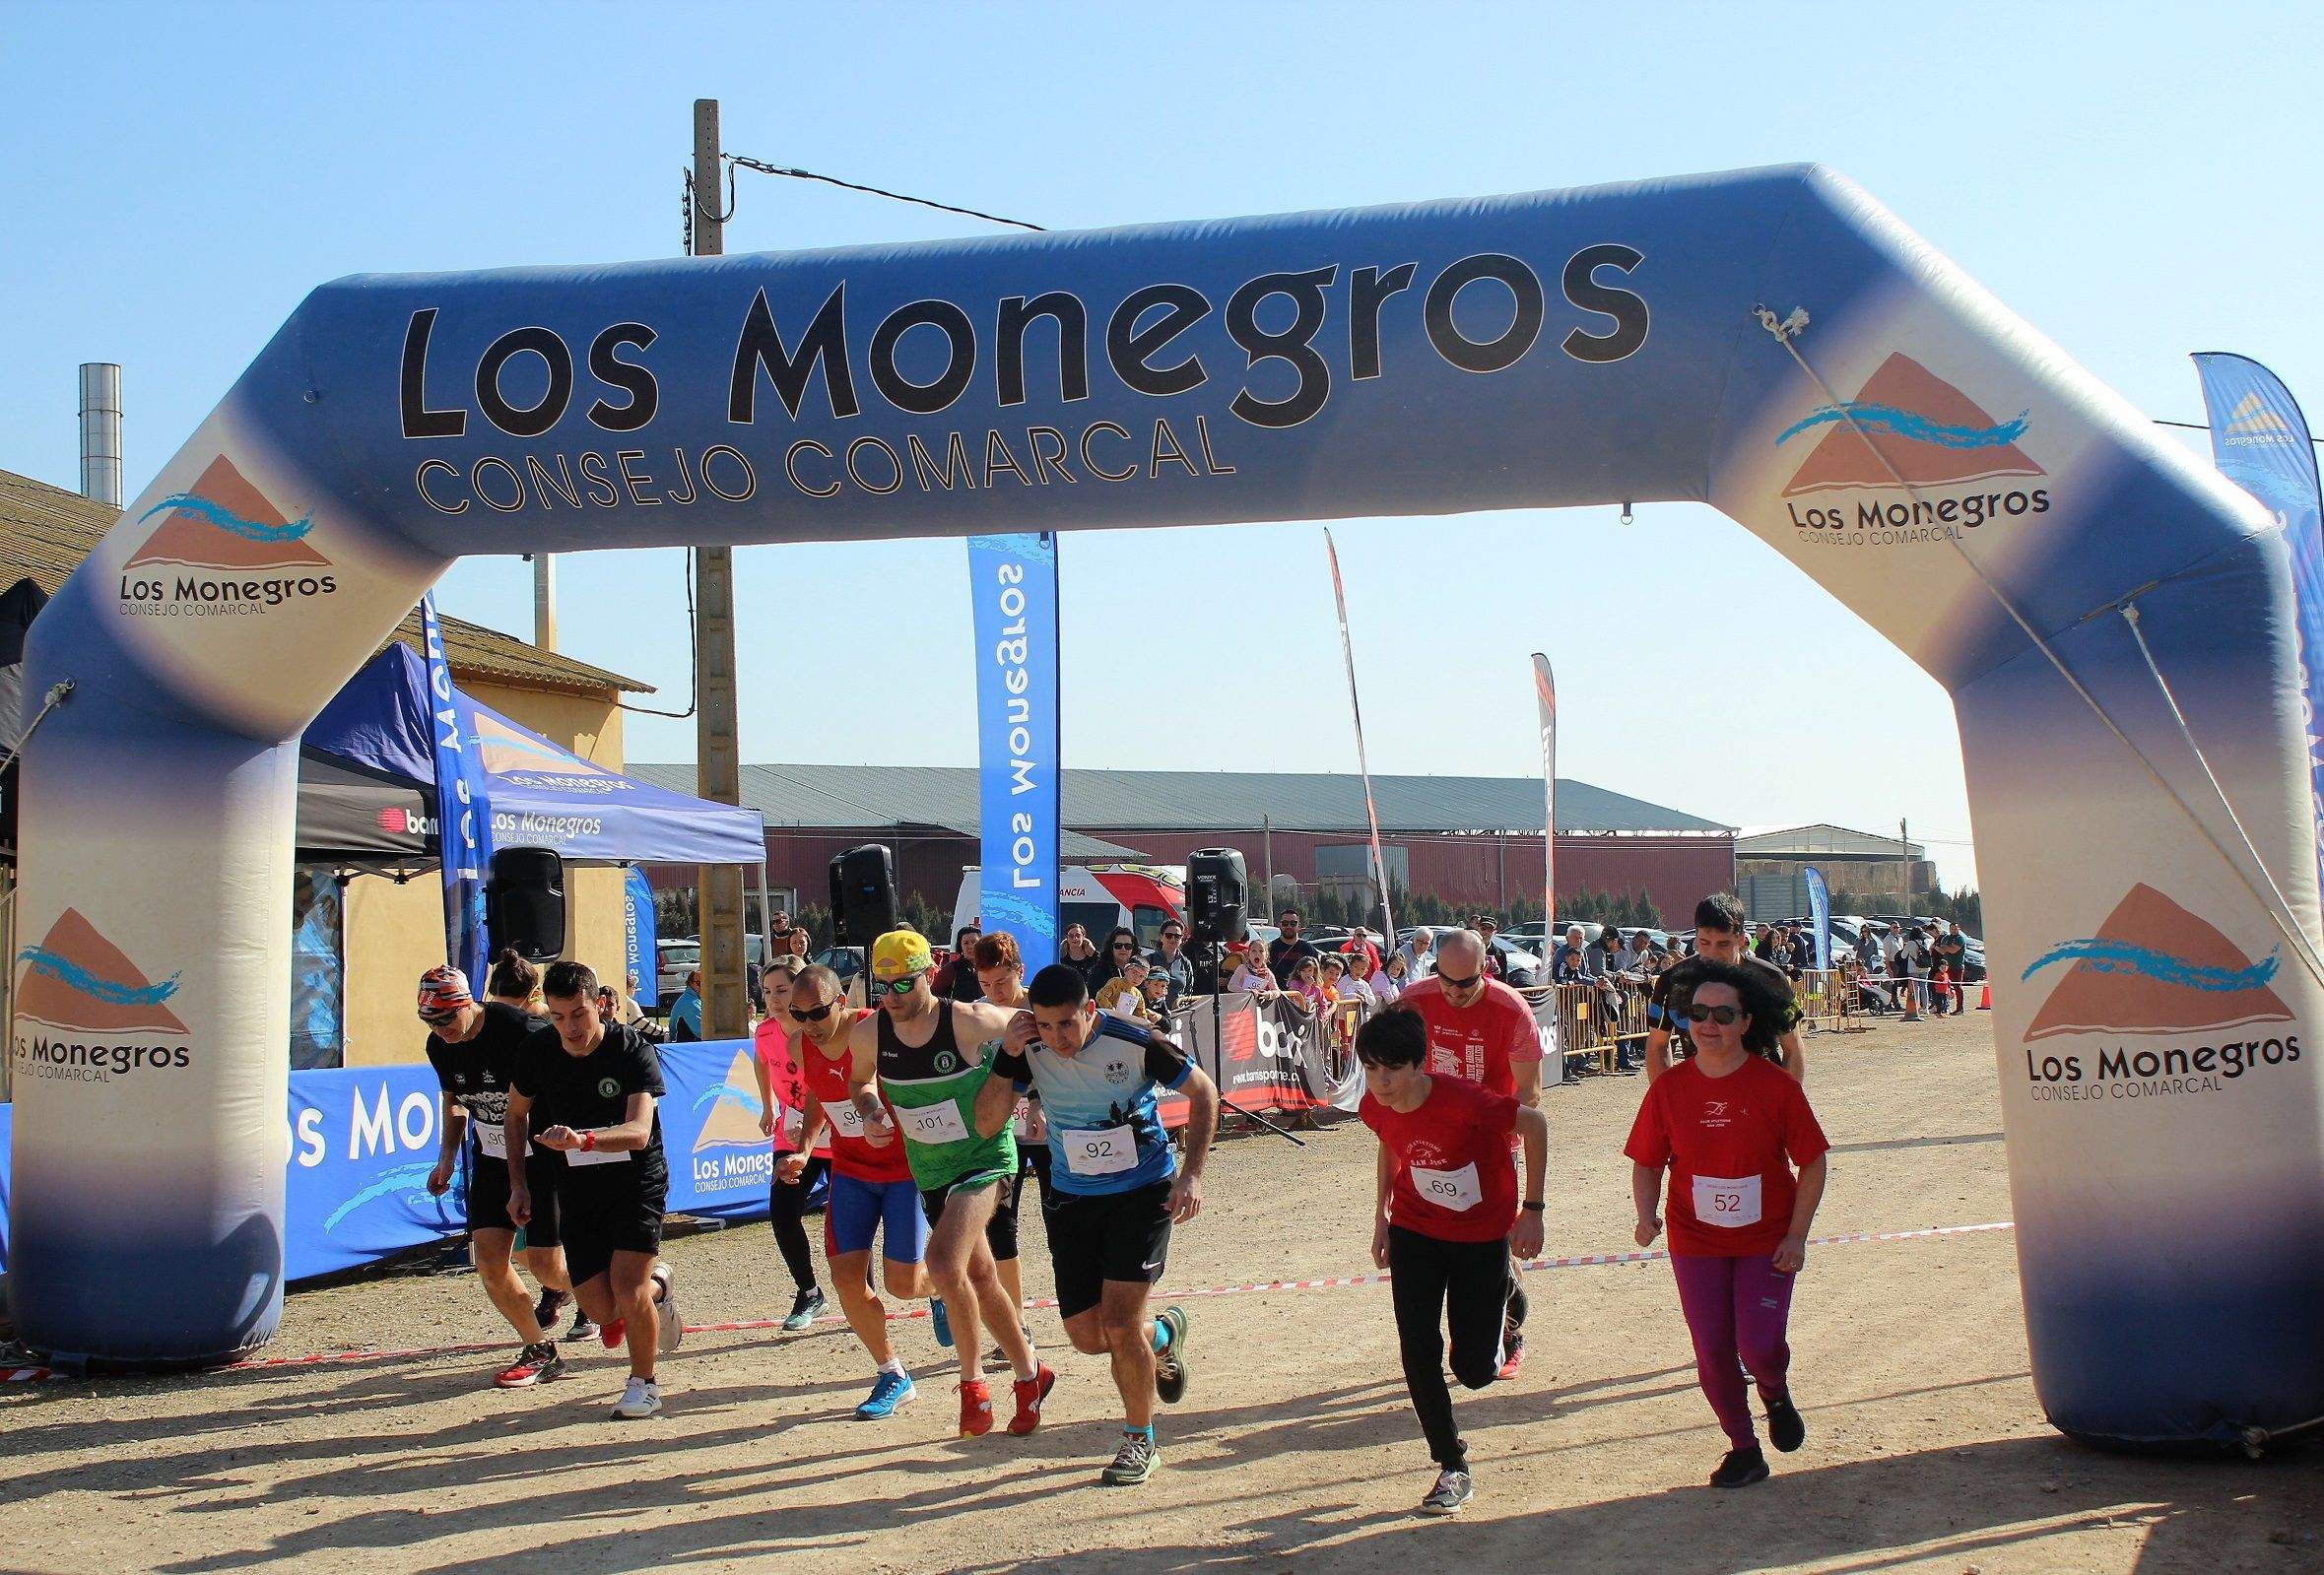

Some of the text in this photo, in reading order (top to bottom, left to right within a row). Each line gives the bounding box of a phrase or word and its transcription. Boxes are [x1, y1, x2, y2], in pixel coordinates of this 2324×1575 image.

[400, 243, 1649, 439] Los Monegros
[416, 415, 1236, 514] CONSEJO COMARCAL
[1787, 489, 2050, 530] Los Monegros
[1798, 525, 1963, 546] CONSEJO COMARCAL
[120, 575, 337, 606] Los Monegros
[119, 603, 266, 617] CONSEJO COMARCAL
[522, 811, 602, 839] Monegros
[1060, 887, 1086, 896] ANCIA
[33, 1035, 190, 1075] Monegros
[2026, 1035, 2301, 1083] Los Monegros
[37, 1065, 110, 1083] COMARCAL
[2031, 1077, 2223, 1101] CONSEJO COMARCAL
[917, 1115, 945, 1130] 101
[1087, 1142, 1113, 1158] 92
[693, 1152, 774, 1180] Los Moneg
[695, 1172, 766, 1194] CONSEJO COMARCAL
[1431, 1180, 1457, 1197] 69
[1715, 1194, 1741, 1213] 52
